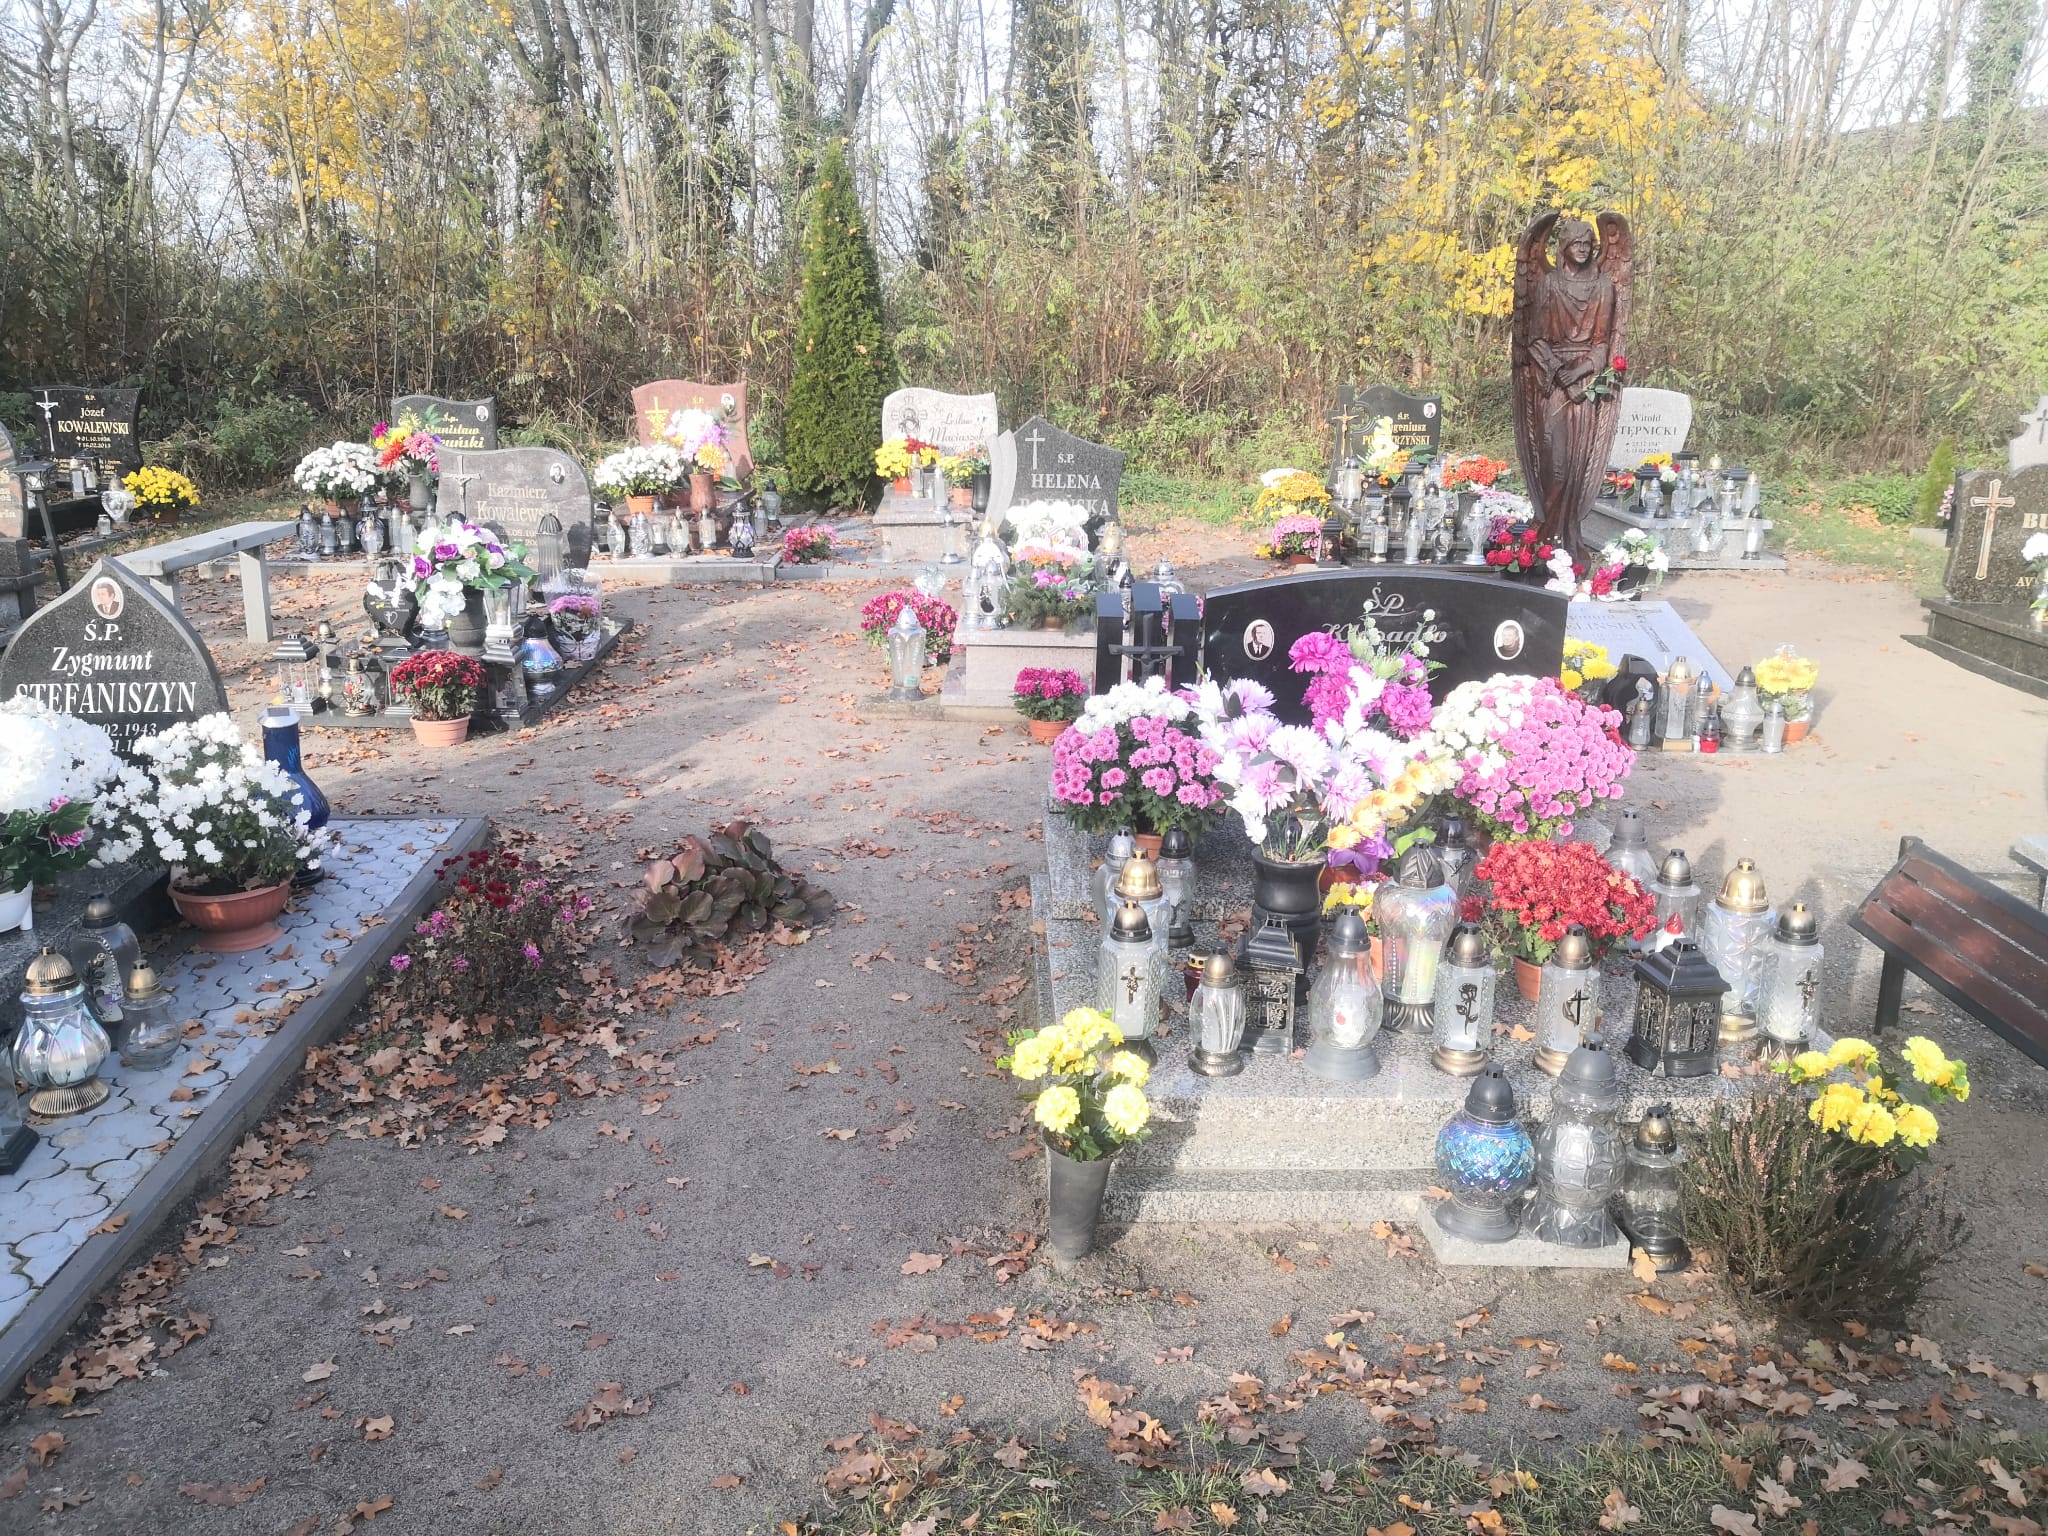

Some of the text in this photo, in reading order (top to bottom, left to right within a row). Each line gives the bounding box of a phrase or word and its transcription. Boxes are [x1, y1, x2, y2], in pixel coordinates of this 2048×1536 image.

[80, 407, 106, 419] Józef
[1632, 413, 1661, 422] Witold
[57, 420, 130, 435] KOWALEWSKI
[1616, 425, 1677, 437] TĘPNICKI
[1031, 473, 1102, 489] HELENA
[487, 482, 548, 500] Kazimierz
[83, 619, 123, 641] Ś.P.
[51, 647, 153, 677] Zygmunt
[15, 681, 197, 714] STEFANISZYN
